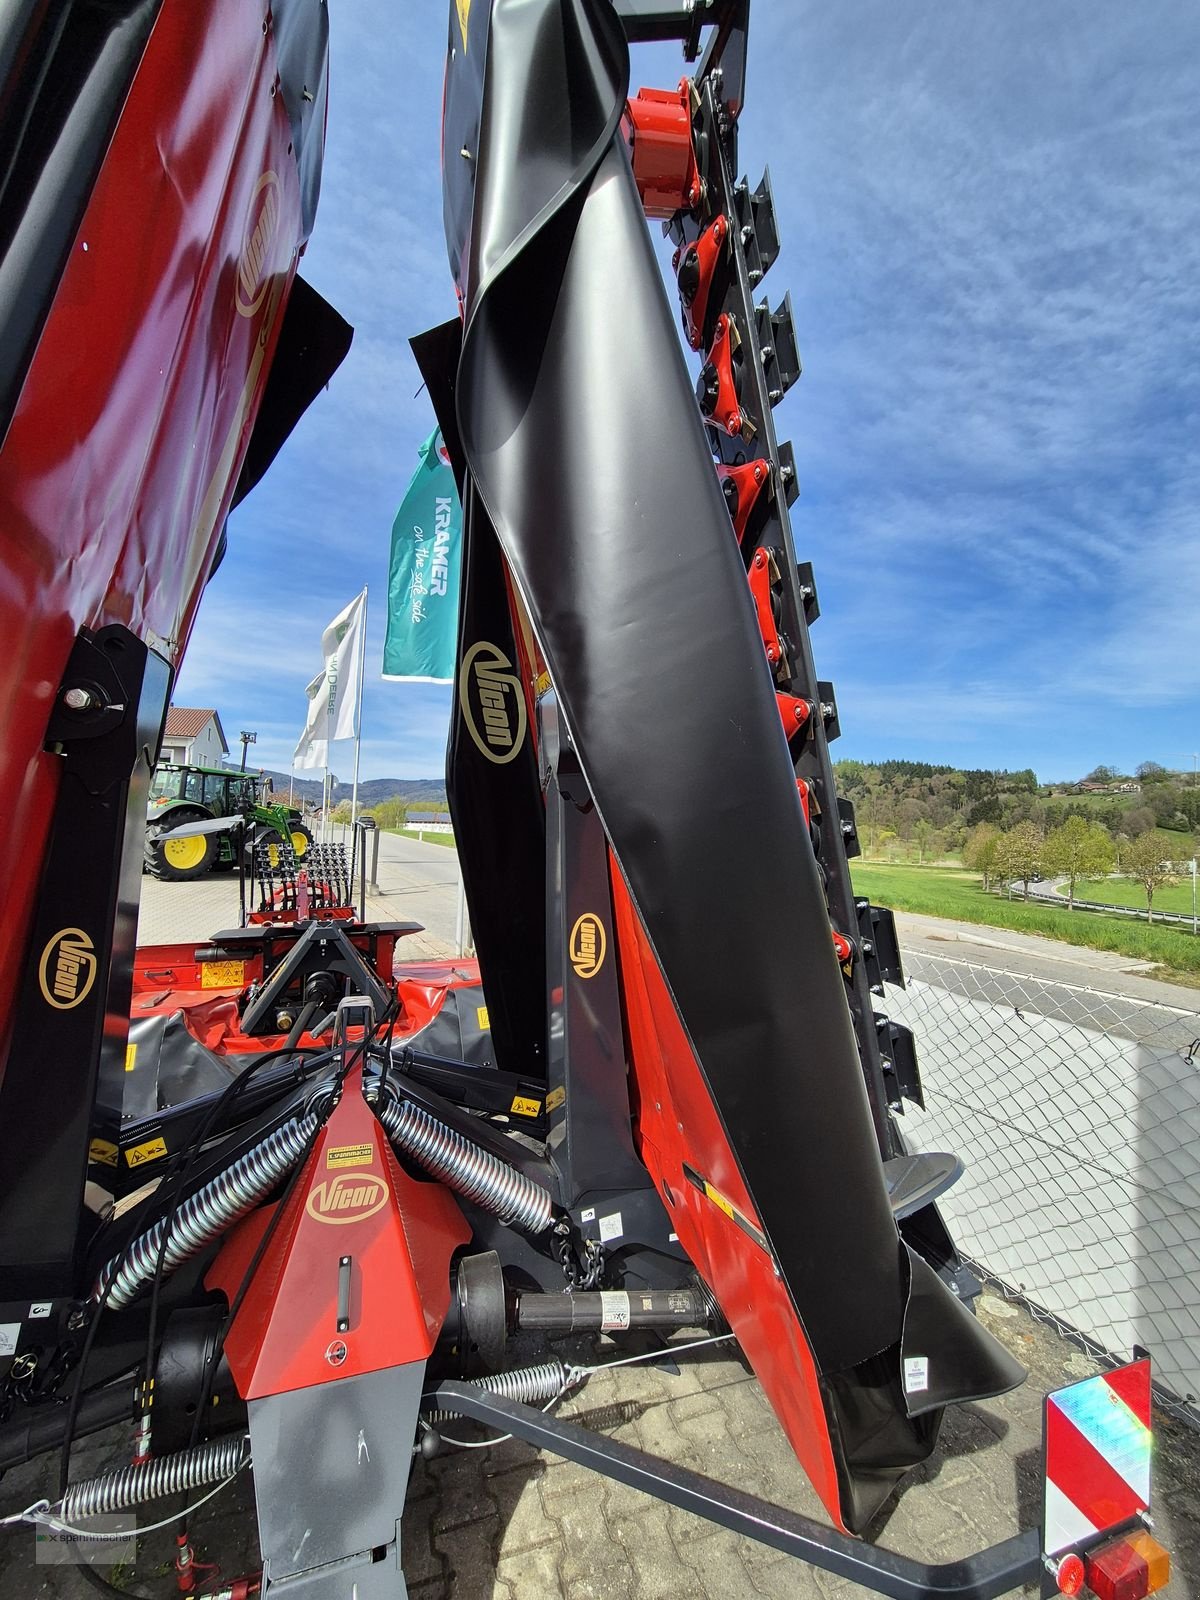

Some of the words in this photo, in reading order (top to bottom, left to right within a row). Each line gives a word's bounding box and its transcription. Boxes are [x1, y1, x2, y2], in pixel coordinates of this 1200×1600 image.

[413, 525, 424, 543] on
[430, 497, 452, 597] KRAMER
[415, 547, 430, 568] the
[409, 570, 428, 597] safe
[411, 598, 427, 624] side
[471, 657, 519, 748] Vicon
[571, 920, 598, 971] Vicon
[52, 938, 96, 1001] Vicon
[316, 1178, 382, 1213] Vicon
